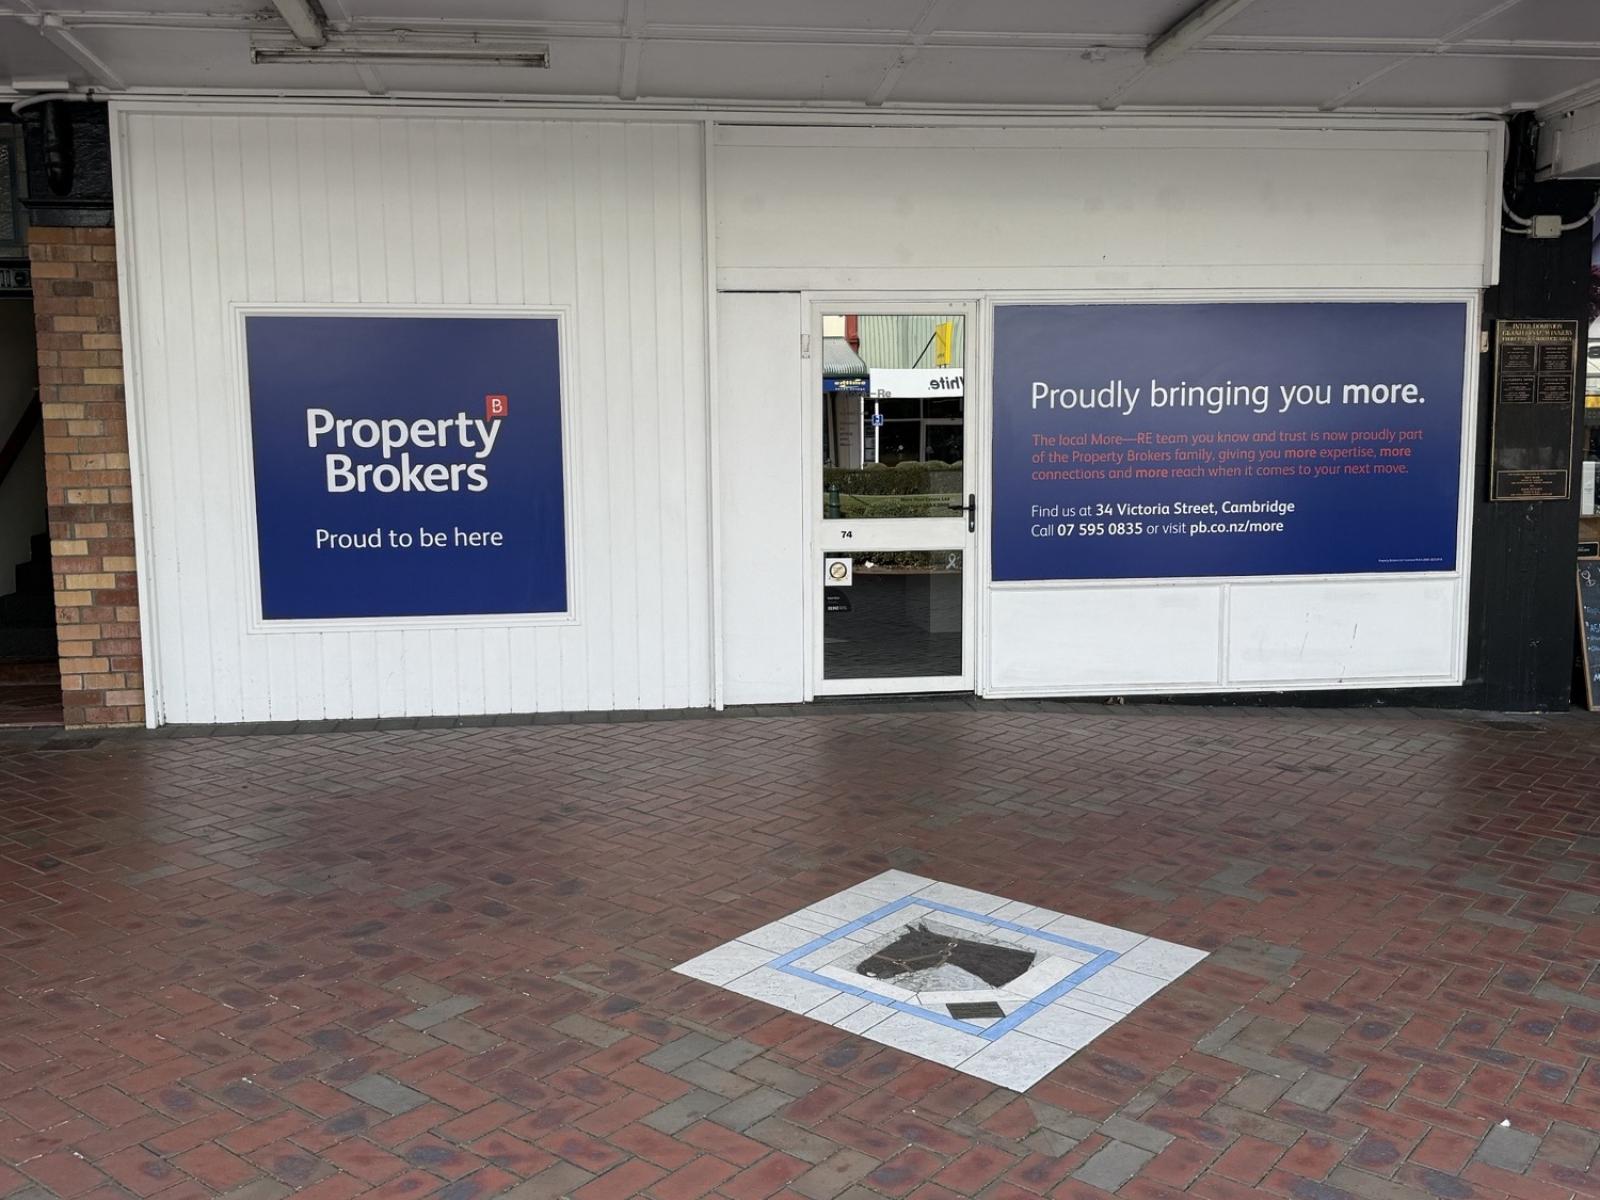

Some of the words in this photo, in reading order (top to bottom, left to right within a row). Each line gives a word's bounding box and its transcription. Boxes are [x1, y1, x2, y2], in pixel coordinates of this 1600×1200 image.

[491, 398, 503, 413] B
[1031, 380, 1141, 416] Proudly
[1150, 379, 1269, 414] bringing
[1279, 385, 1332, 412] you
[1342, 381, 1426, 404] more.
[306, 408, 501, 459] Property
[1032, 434, 1056, 446] The
[1059, 433, 1087, 446] local
[1156, 433, 1188, 444] team
[1191, 434, 1214, 446] you
[1217, 431, 1250, 443] know
[1252, 431, 1276, 442] and
[1279, 431, 1307, 442] trust
[1310, 430, 1320, 441] is
[1322, 432, 1348, 441] now
[1351, 428, 1396, 443] proudly
[1398, 429, 1424, 442] part
[1032, 451, 1046, 463] of
[1048, 451, 1068, 463] the
[1072, 450, 1124, 465] Property
[1127, 449, 1171, 462] Brokers
[1174, 449, 1216, 464] family,
[1218, 448, 1256, 462] giving
[1258, 451, 1281, 462] you
[1284, 449, 1317, 459] more
[1319, 446, 1377, 461] expertise,
[1379, 446, 1412, 457] more
[326, 452, 489, 492] Brokers
[1031, 469, 1105, 481] connections
[1108, 467, 1132, 479] and
[1135, 468, 1169, 478] more
[1171, 466, 1205, 478] reach
[1207, 465, 1242, 477] when
[1244, 465, 1253, 476] it
[1256, 466, 1296, 476] comes
[1298, 465, 1312, 476] to
[1313, 466, 1341, 478] your
[1343, 464, 1370, 475] next
[1373, 464, 1409, 474] move.
[1031, 503, 1059, 518] Find
[1061, 507, 1076, 517] us
[1078, 505, 1093, 517] at
[1095, 503, 1113, 517] 34
[1116, 502, 1170, 516] Victoria
[1173, 501, 1218, 517] Street,
[1221, 500, 1295, 517] Cambridge
[316, 528, 382, 549] Proud
[388, 529, 413, 548] to
[419, 527, 448, 547] be
[454, 526, 504, 546] here
[840, 530, 853, 539] 74
[1031, 523, 1054, 538] Call
[1057, 523, 1075, 537] 07
[1078, 522, 1104, 537] 595
[1107, 522, 1143, 536] 0835
[1146, 524, 1160, 535] or
[1161, 521, 1187, 534] visit
[1189, 518, 1284, 536] pb.co.nz/more
